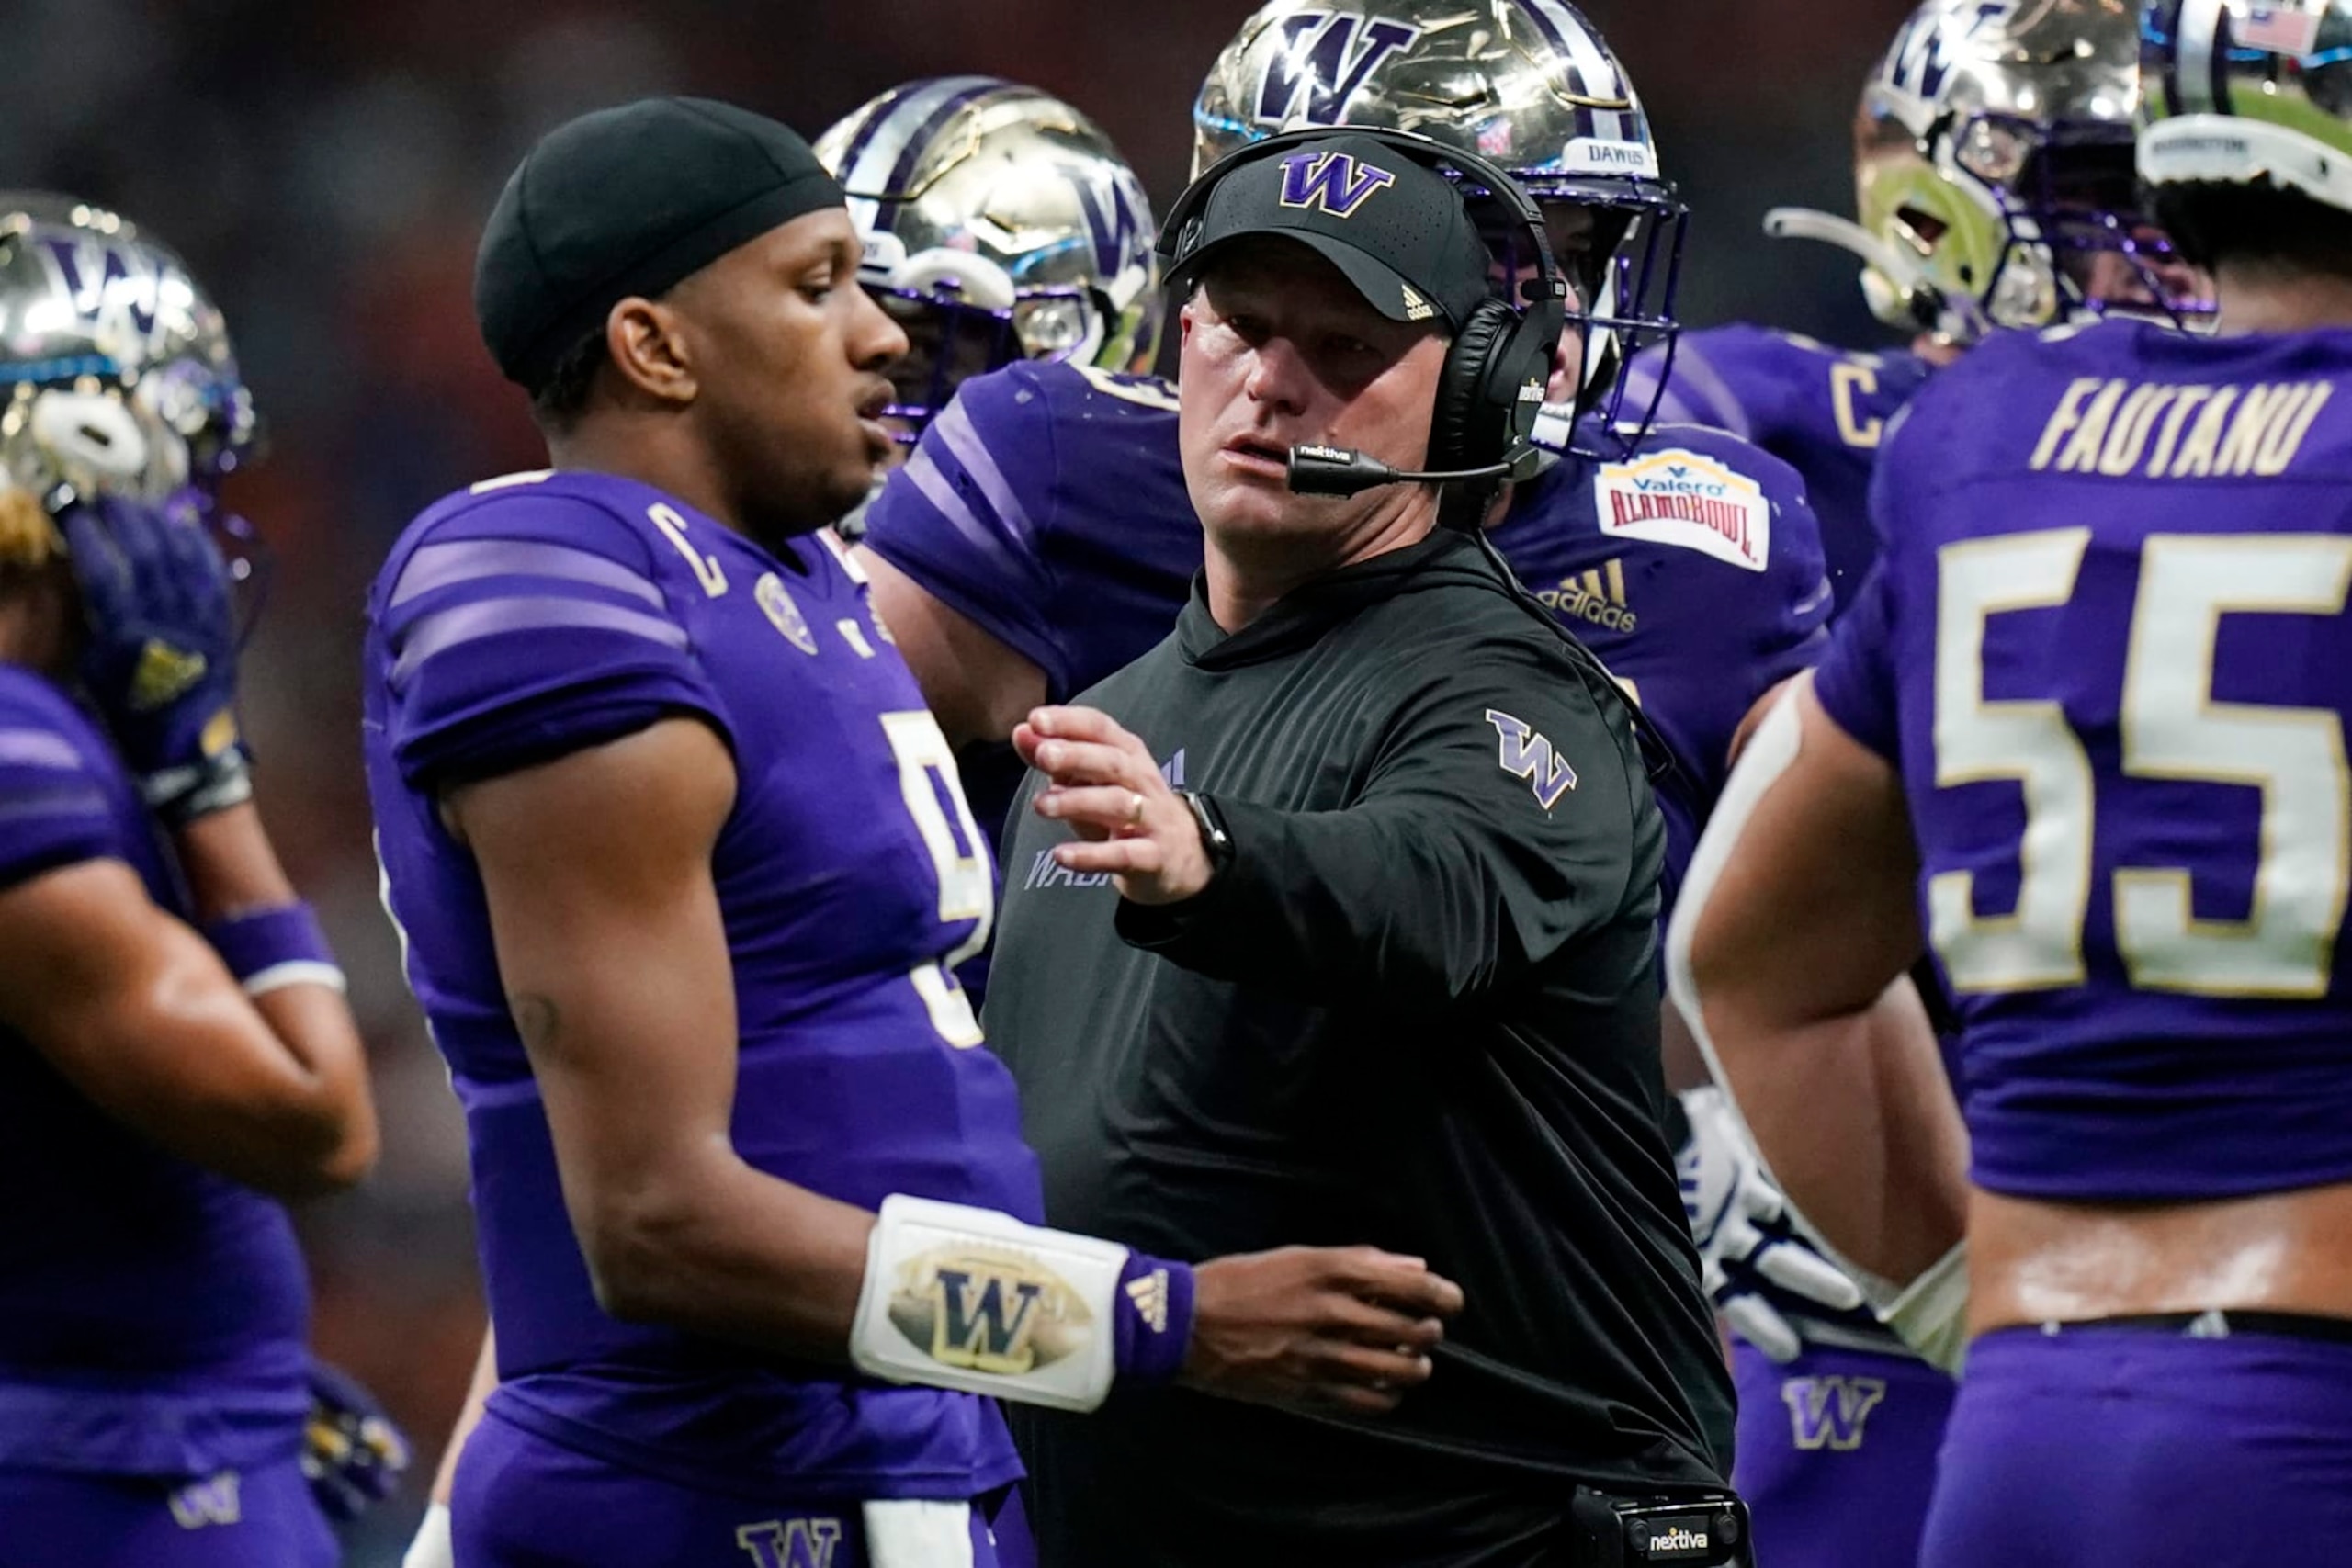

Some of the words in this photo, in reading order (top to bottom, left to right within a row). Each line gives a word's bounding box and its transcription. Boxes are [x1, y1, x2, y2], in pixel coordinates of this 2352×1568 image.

[1253, 9, 1421, 127] W
[1279, 149, 1396, 219] W
[1829, 362, 1882, 447] C
[1632, 477, 1723, 497] Valero
[647, 502, 729, 597] C
[1536, 590, 1636, 633] adidas
[1486, 708, 1578, 809] W
[1929, 525, 2352, 998] 55
[933, 1267, 1043, 1372] W
[1781, 1376, 1886, 1450] W
[736, 1517, 842, 1568] W
[1650, 1526, 1708, 1551] nextiva
